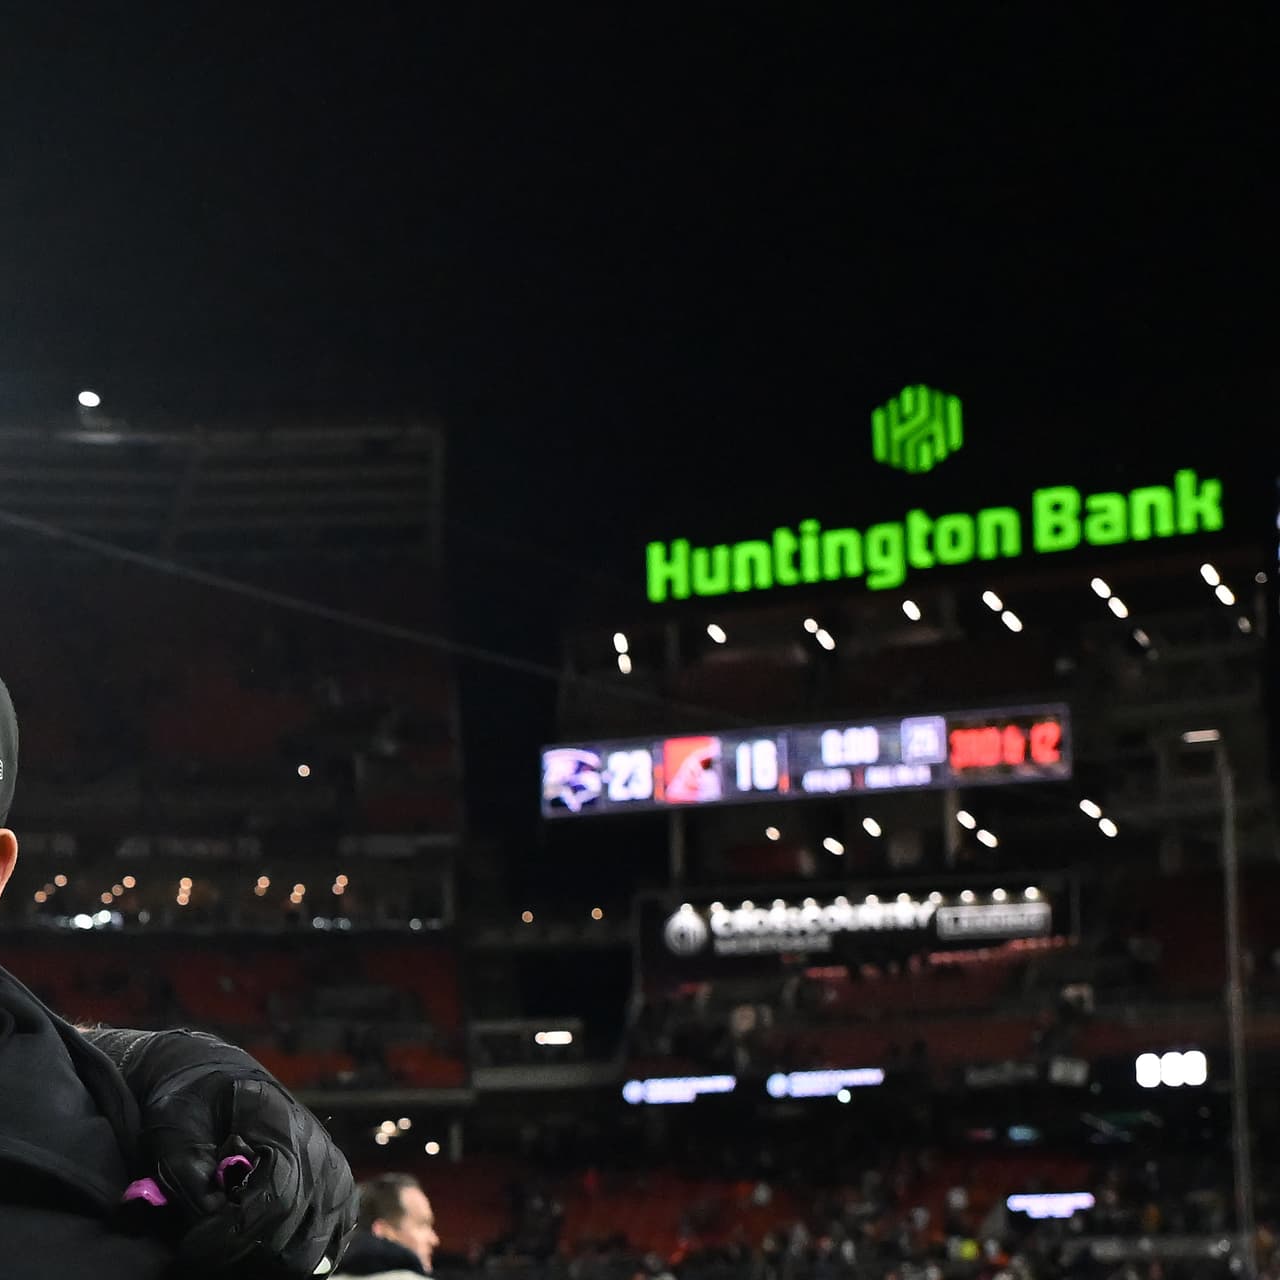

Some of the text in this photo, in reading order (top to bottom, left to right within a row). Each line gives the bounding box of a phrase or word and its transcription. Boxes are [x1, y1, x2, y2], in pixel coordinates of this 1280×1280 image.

[646, 468, 1222, 602] Huntington Bank
[607, 750, 653, 801] 23
